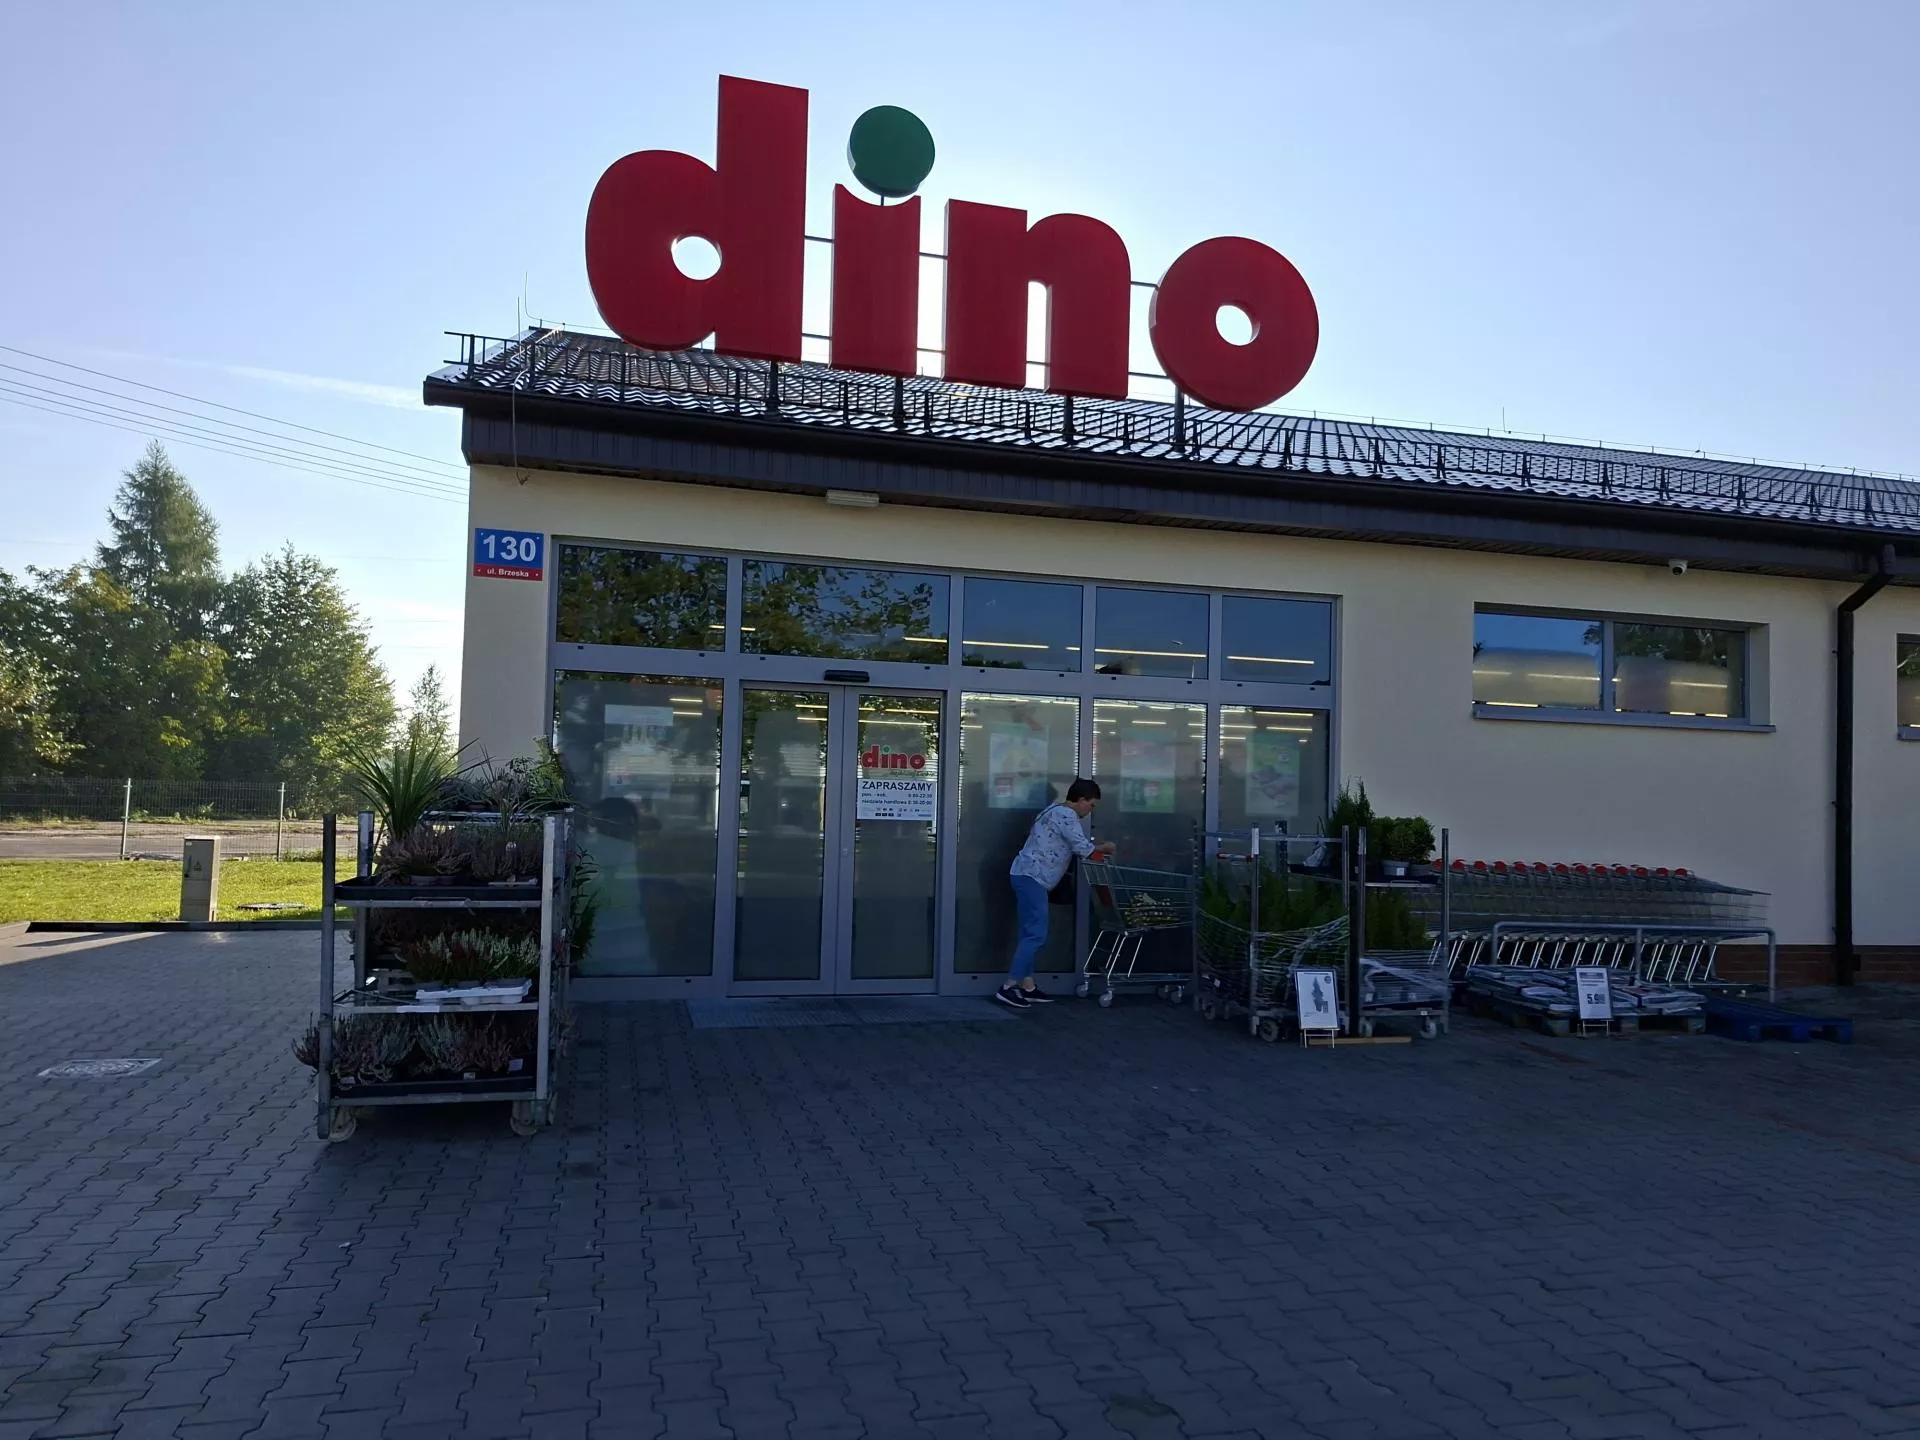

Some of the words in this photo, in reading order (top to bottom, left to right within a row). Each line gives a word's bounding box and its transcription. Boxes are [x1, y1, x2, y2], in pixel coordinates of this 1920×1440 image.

[585, 74, 1319, 412] dino
[483, 535, 536, 562] 130
[487, 568, 497, 576] ul.
[498, 568, 529, 577] Brzeska
[861, 744, 926, 770] dino
[862, 781, 933, 792] ZAPRASZAMY
